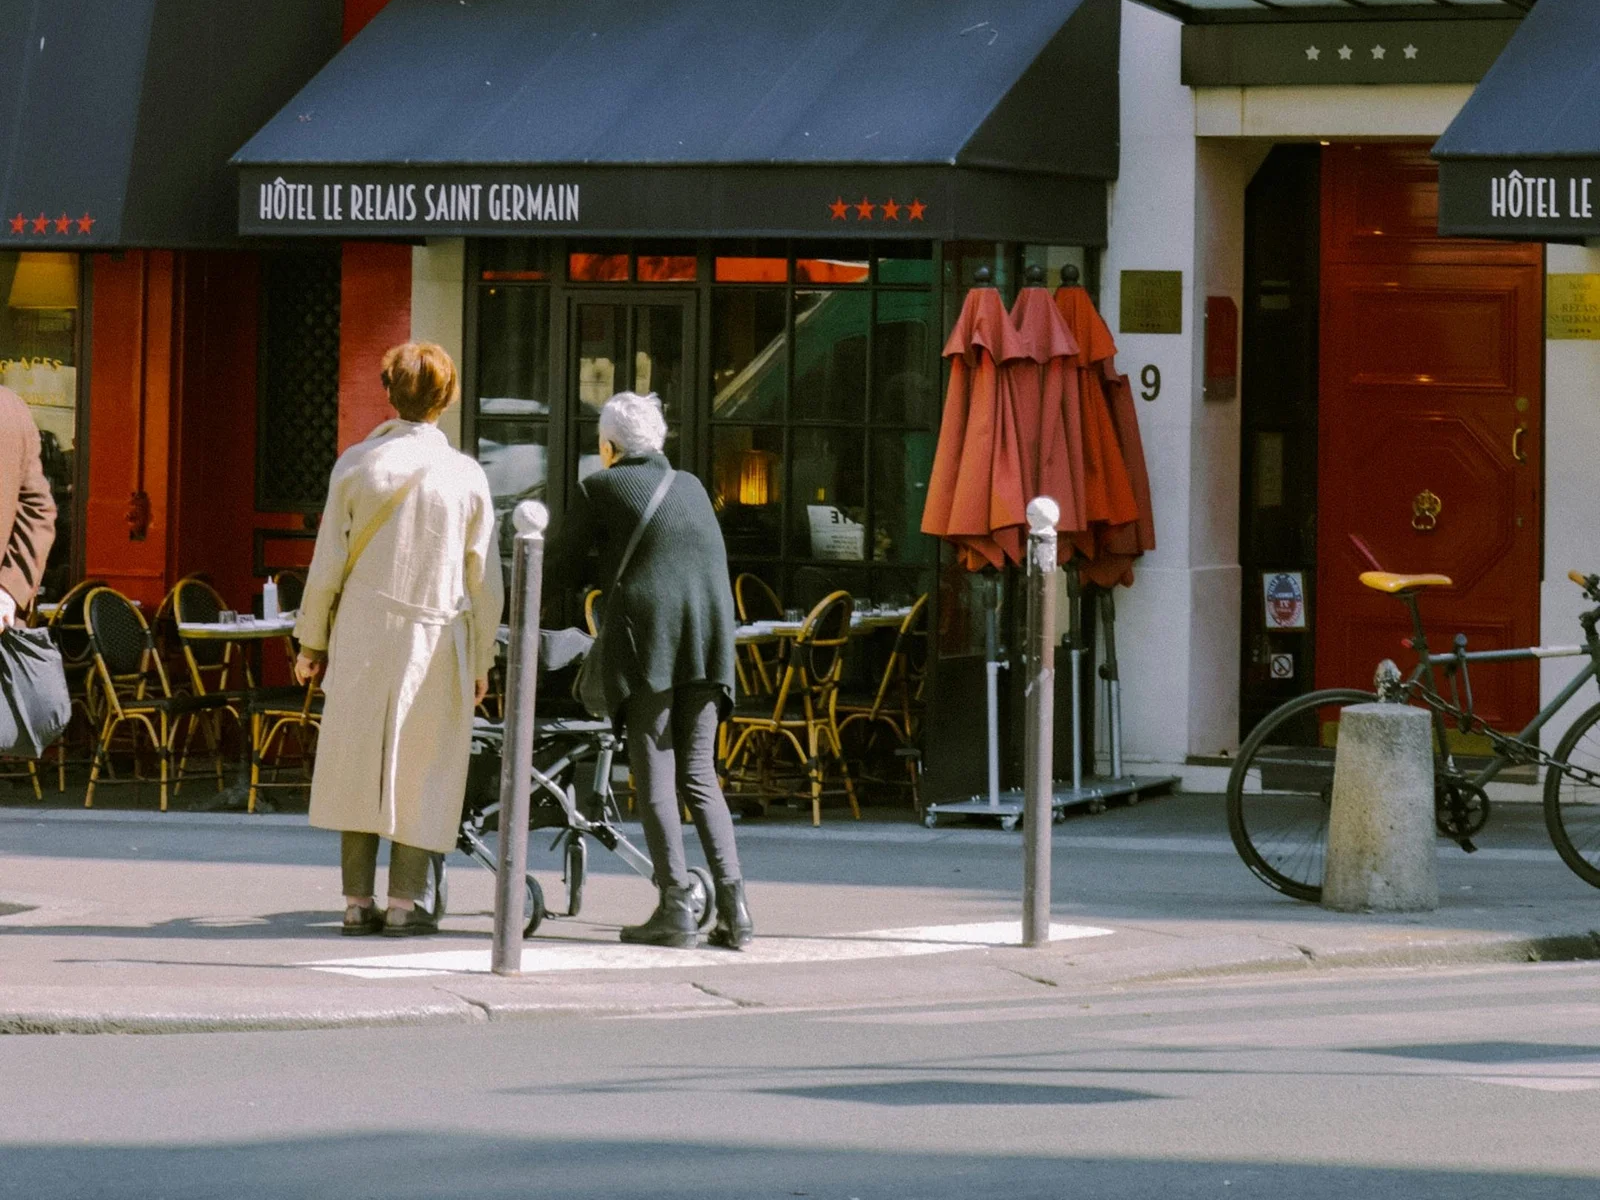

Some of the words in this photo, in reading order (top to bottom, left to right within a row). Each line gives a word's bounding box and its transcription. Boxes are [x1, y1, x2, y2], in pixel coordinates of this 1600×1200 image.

[260, 176, 316, 220] HÔTEL
[323, 184, 343, 220] LE
[350, 184, 417, 221] RELAIS
[424, 184, 482, 221] SAINT
[488, 184, 579, 221] GERMAIN
[1491, 169, 1560, 218] HÔTEL
[1569, 177, 1592, 218] LE
[1140, 364, 1161, 402] 9
